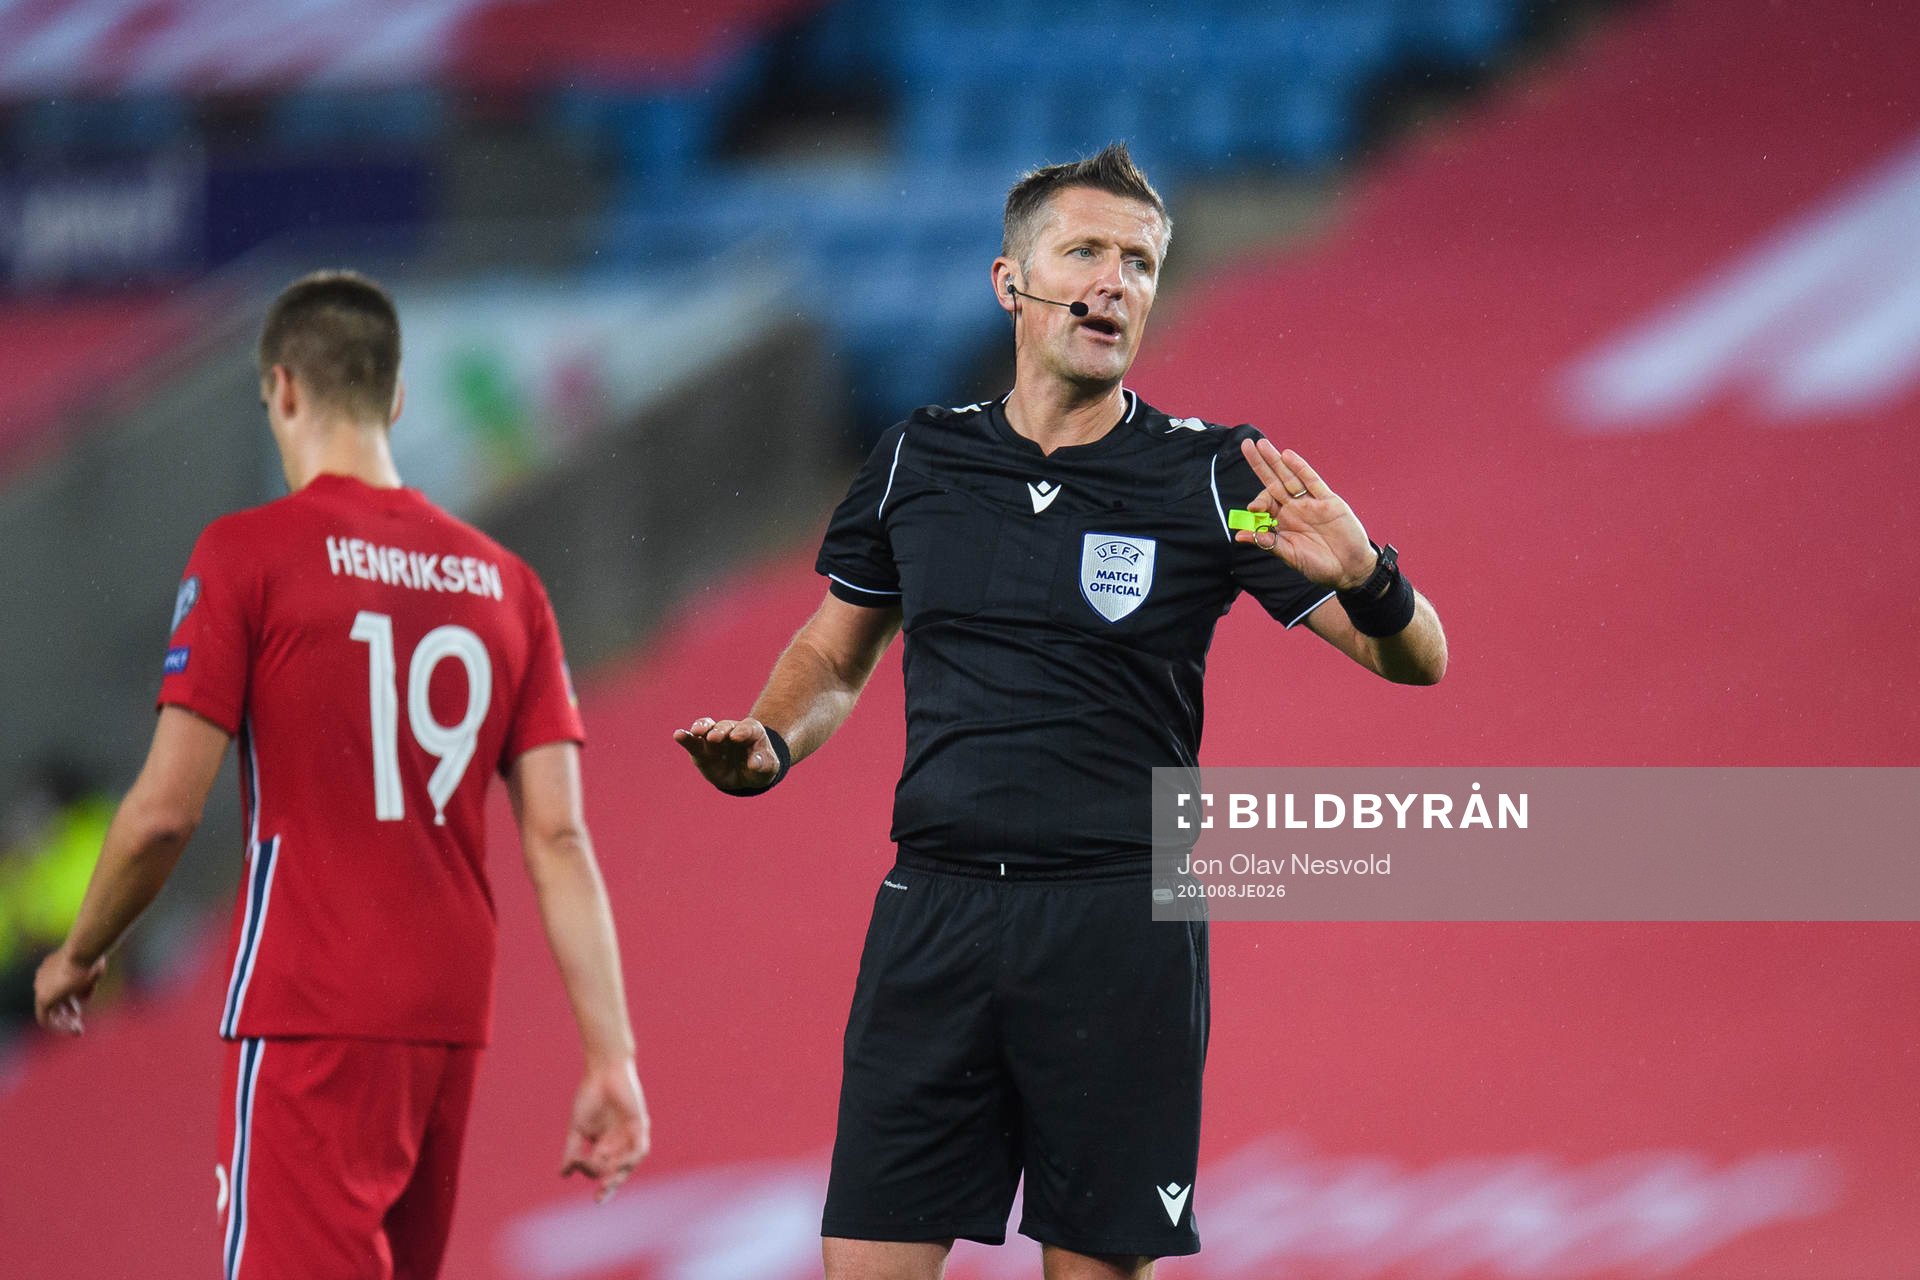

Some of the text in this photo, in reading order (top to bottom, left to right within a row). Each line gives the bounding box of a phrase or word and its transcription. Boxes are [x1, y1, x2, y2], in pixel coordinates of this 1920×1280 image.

[1097, 545, 1140, 562] UEFA
[325, 535, 504, 602] HENRIKSEN
[1096, 569, 1138, 583] MATCH
[1089, 582, 1142, 597] OFFICIAL
[350, 610, 492, 826] 19
